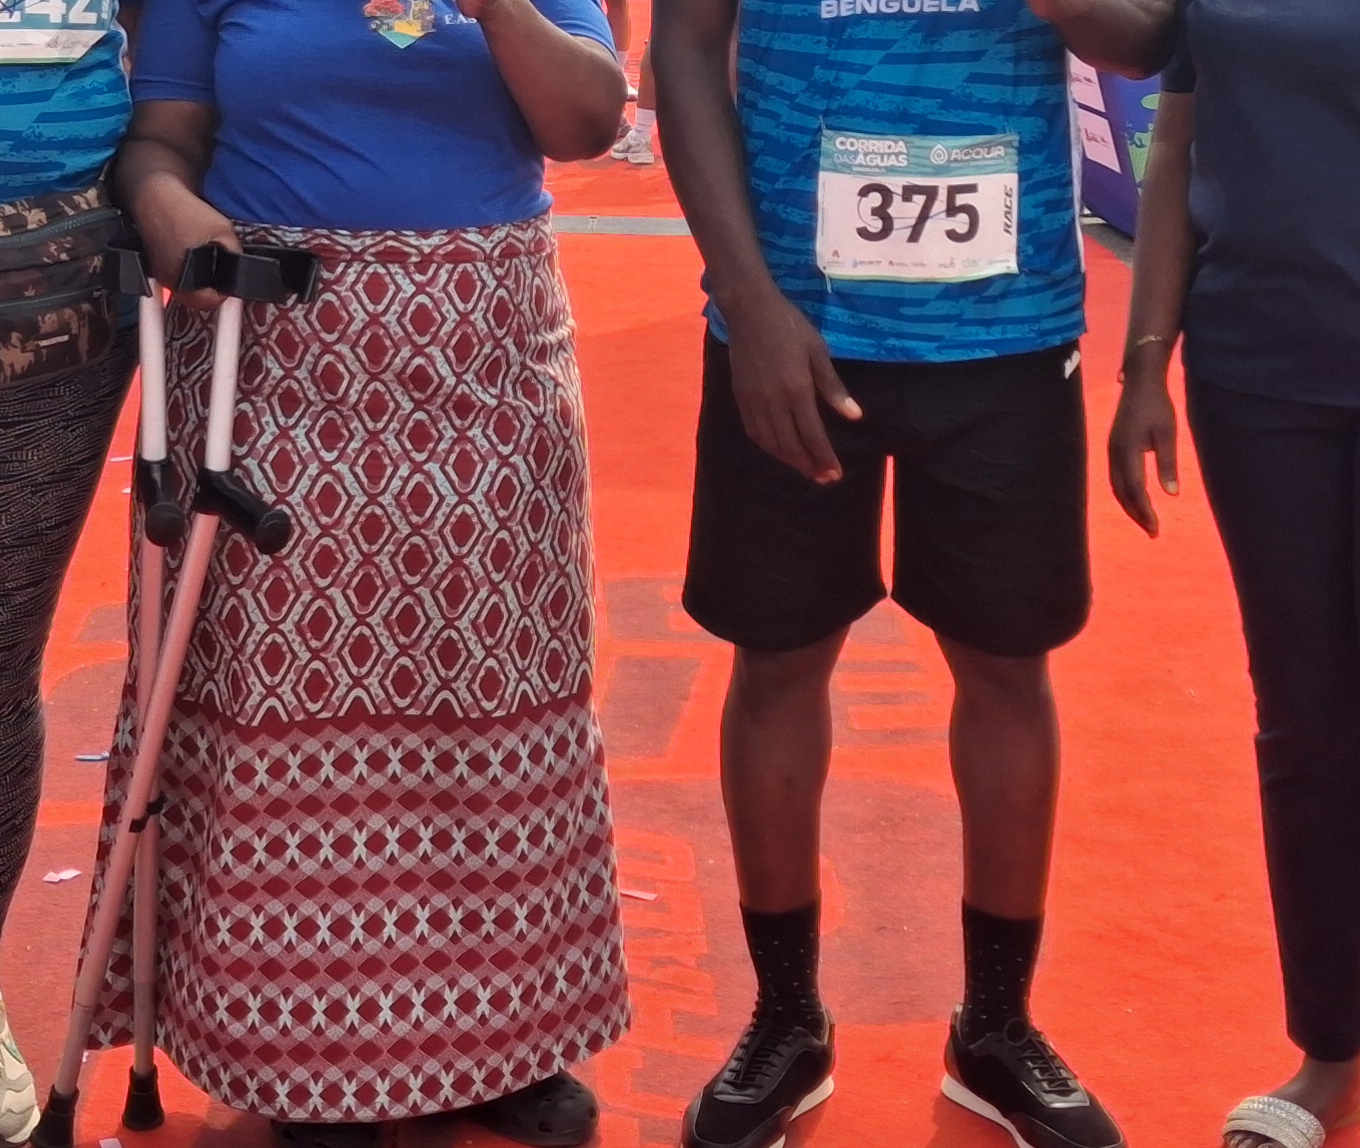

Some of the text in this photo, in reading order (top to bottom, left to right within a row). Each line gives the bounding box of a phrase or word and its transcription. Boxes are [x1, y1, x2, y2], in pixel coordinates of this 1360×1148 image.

[835, 136, 908, 153] CORRIDA
[950, 145, 1005, 161] ACQUA
[856, 182, 980, 244] 375
[1003, 184, 1014, 236] RACE
